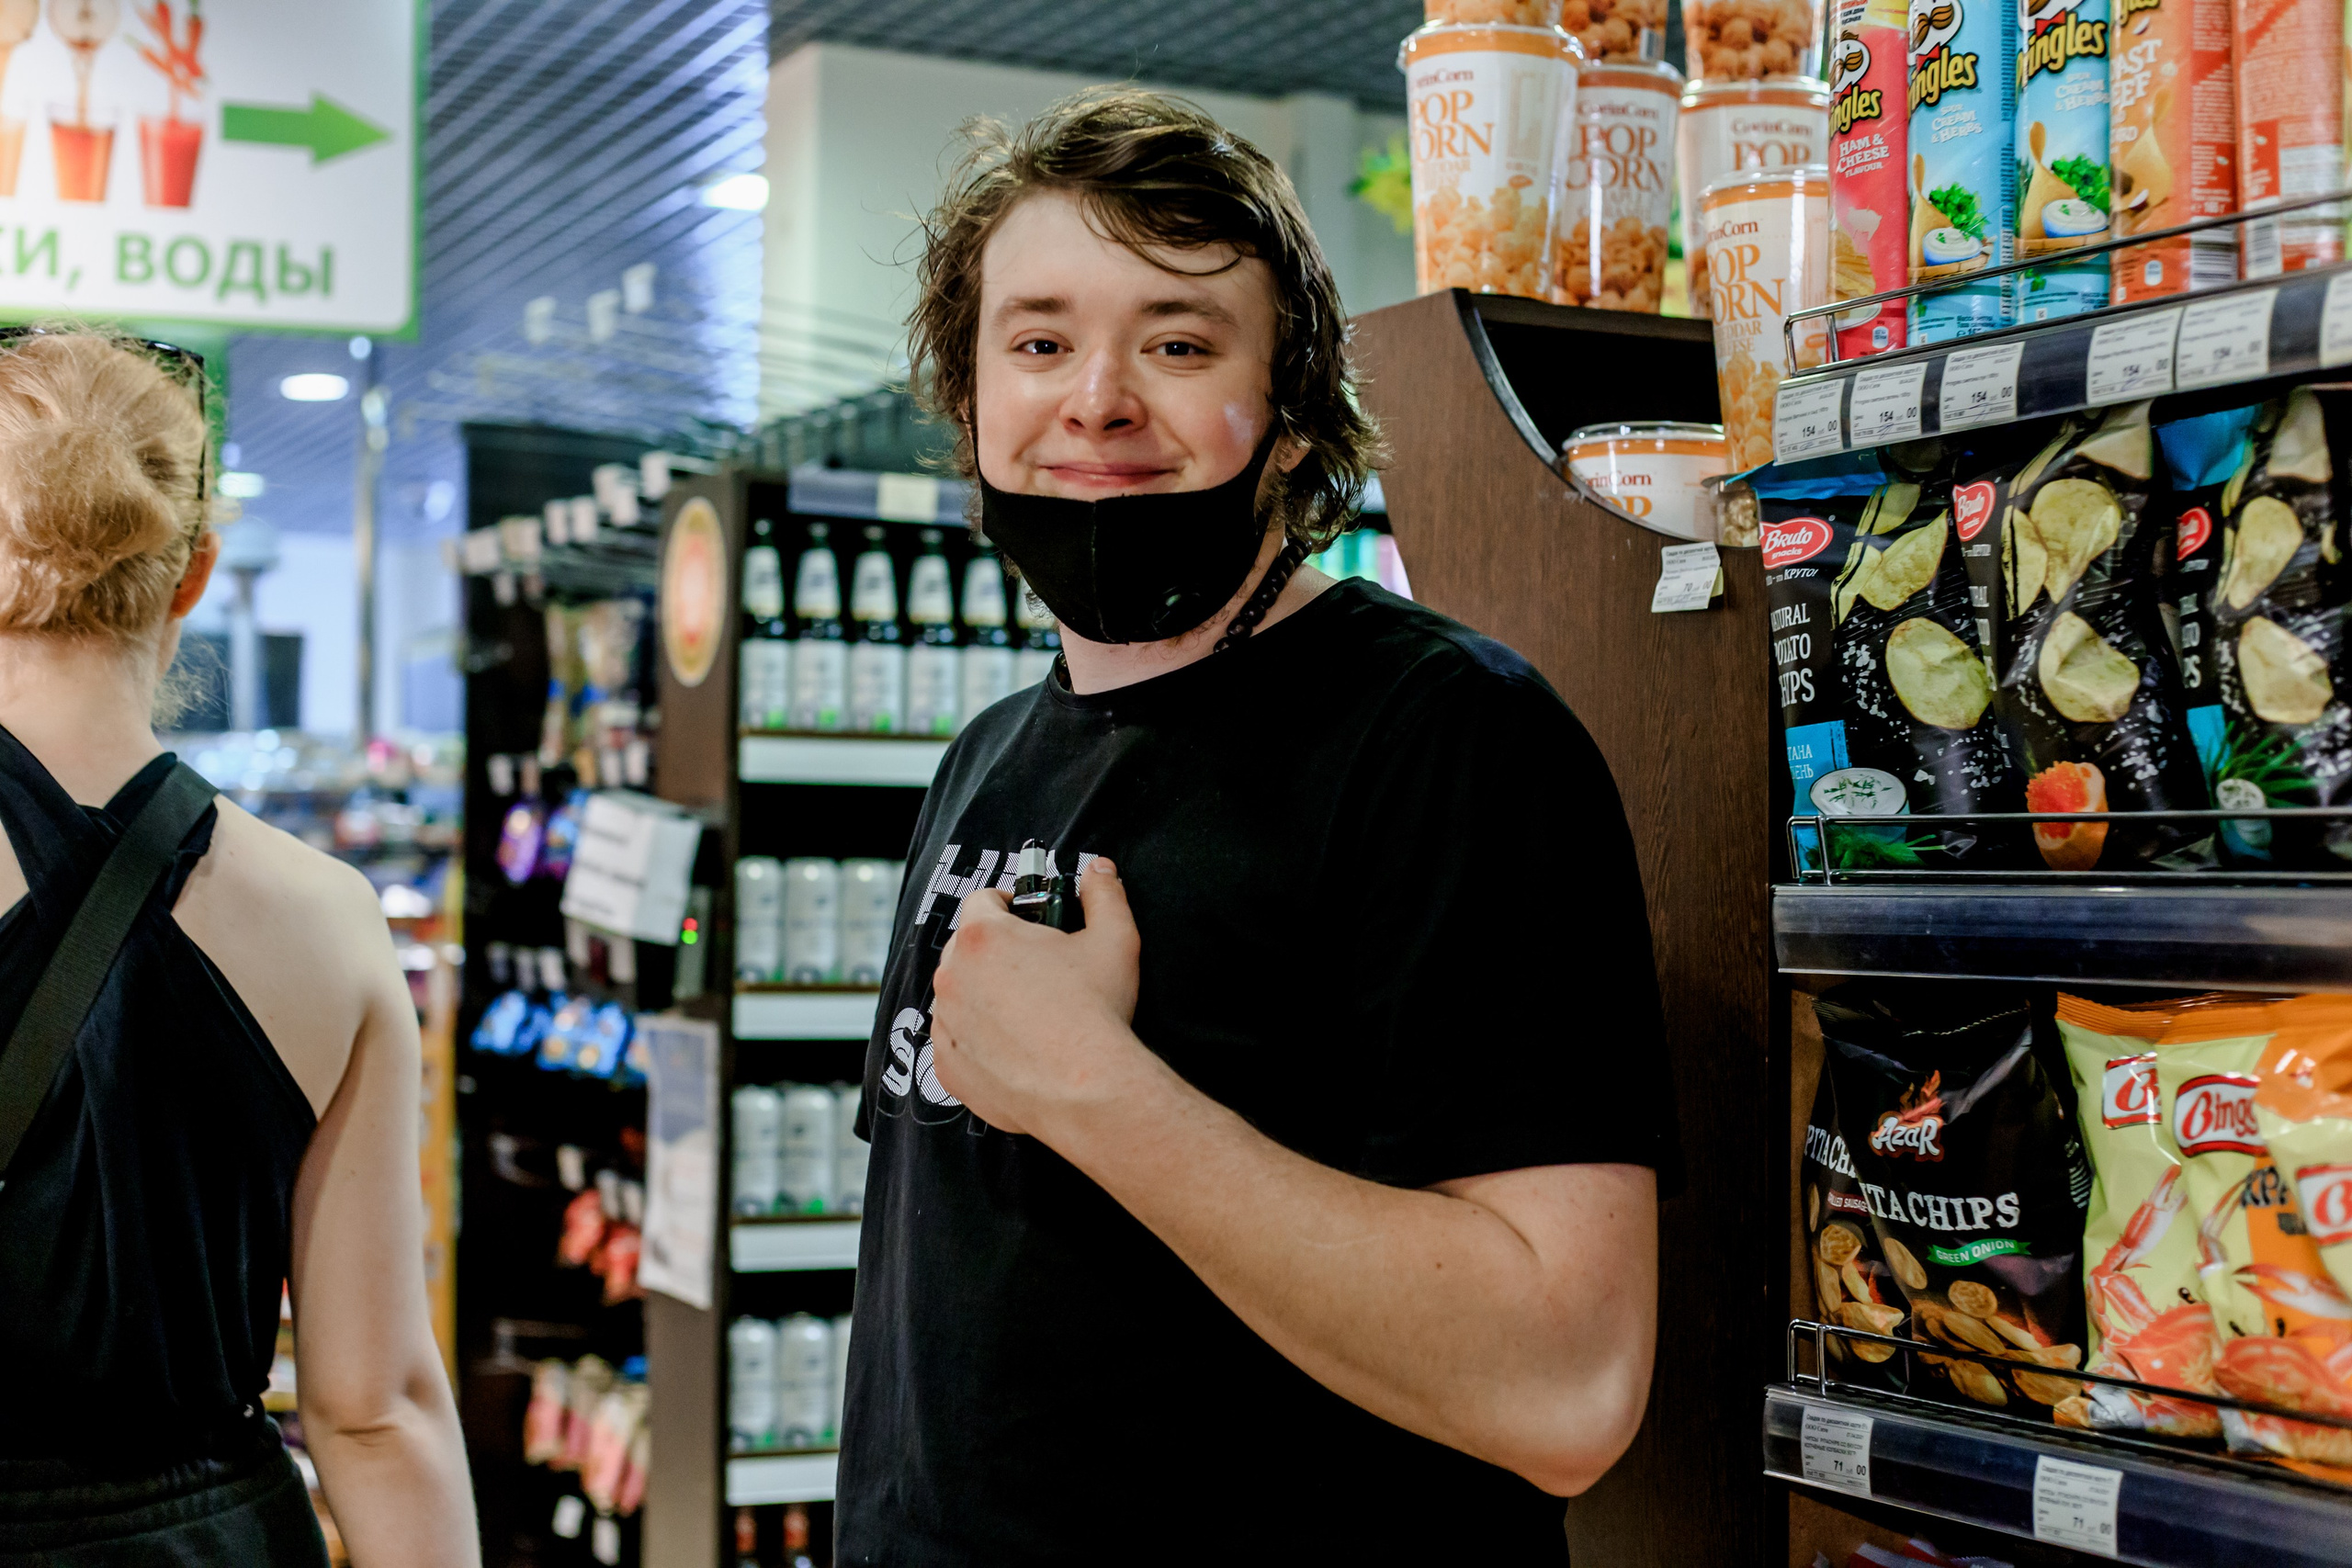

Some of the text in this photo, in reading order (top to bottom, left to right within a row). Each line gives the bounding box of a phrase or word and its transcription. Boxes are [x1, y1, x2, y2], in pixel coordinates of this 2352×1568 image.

[2017, 13, 2106, 90] ringles
[2112, 39, 2162, 81] AST
[1907, 47, 1977, 112] ingles
[2112, 71, 2152, 109] EEF
[1828, 85, 1882, 136] ingles
[1931, 110, 1977, 131] CREAM
[1416, 122, 1496, 164] ORN
[1577, 123, 1658, 158] POP
[1839, 133, 1884, 158] HAM &
[1837, 146, 1890, 174] CHEESE
[1845, 162, 1883, 178] FLAVOUR
[0, 226, 335, 302] И, ВОДЫ
[1713, 277, 1786, 326] ORN
[1971, 390, 1987, 404] 154
[1802, 420, 1838, 439] 154 00
[1879, 406, 1917, 423] 154 00
[1762, 525, 1814, 554] Bruto
[1771, 547, 1804, 560] snacks
[1779, 668, 1815, 708] HIPS
[1787, 743, 1814, 761] ТАНА
[1804, 1124, 1857, 1179] PITACH
[1859, 1181, 2021, 1231] ITACHIPS
[1936, 1240, 2016, 1263] GREEN ONION
[1834, 1461, 1866, 1475] 71 00
